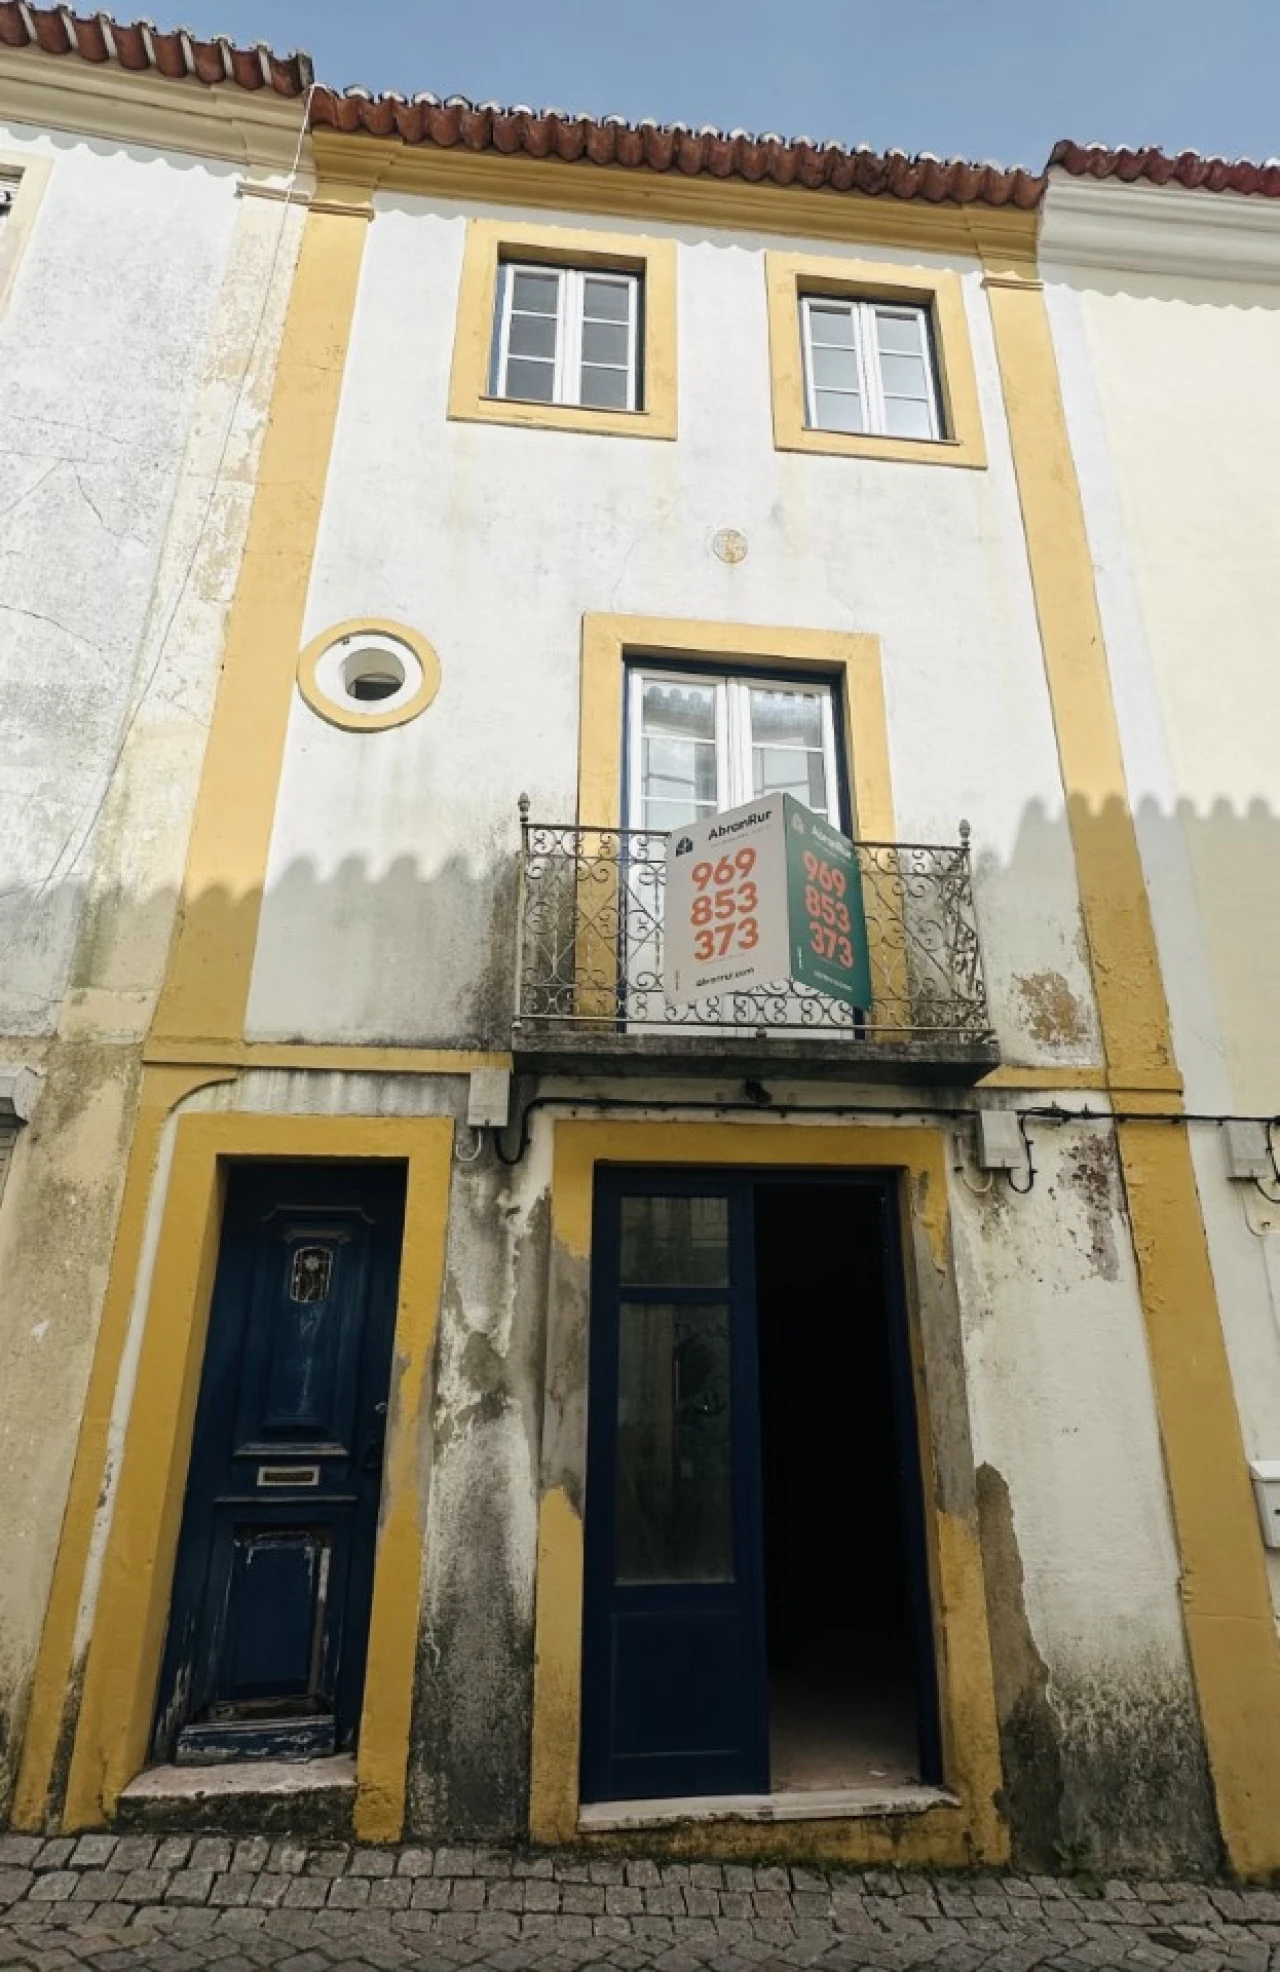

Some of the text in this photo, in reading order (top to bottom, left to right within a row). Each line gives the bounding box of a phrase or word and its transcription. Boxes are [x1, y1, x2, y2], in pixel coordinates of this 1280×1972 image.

[691, 847, 756, 891] 969
[803, 851, 846, 897] 969
[690, 881, 758, 926] 853
[805, 885, 850, 932] 853
[694, 917, 758, 960] 373
[810, 921, 853, 968] 373
